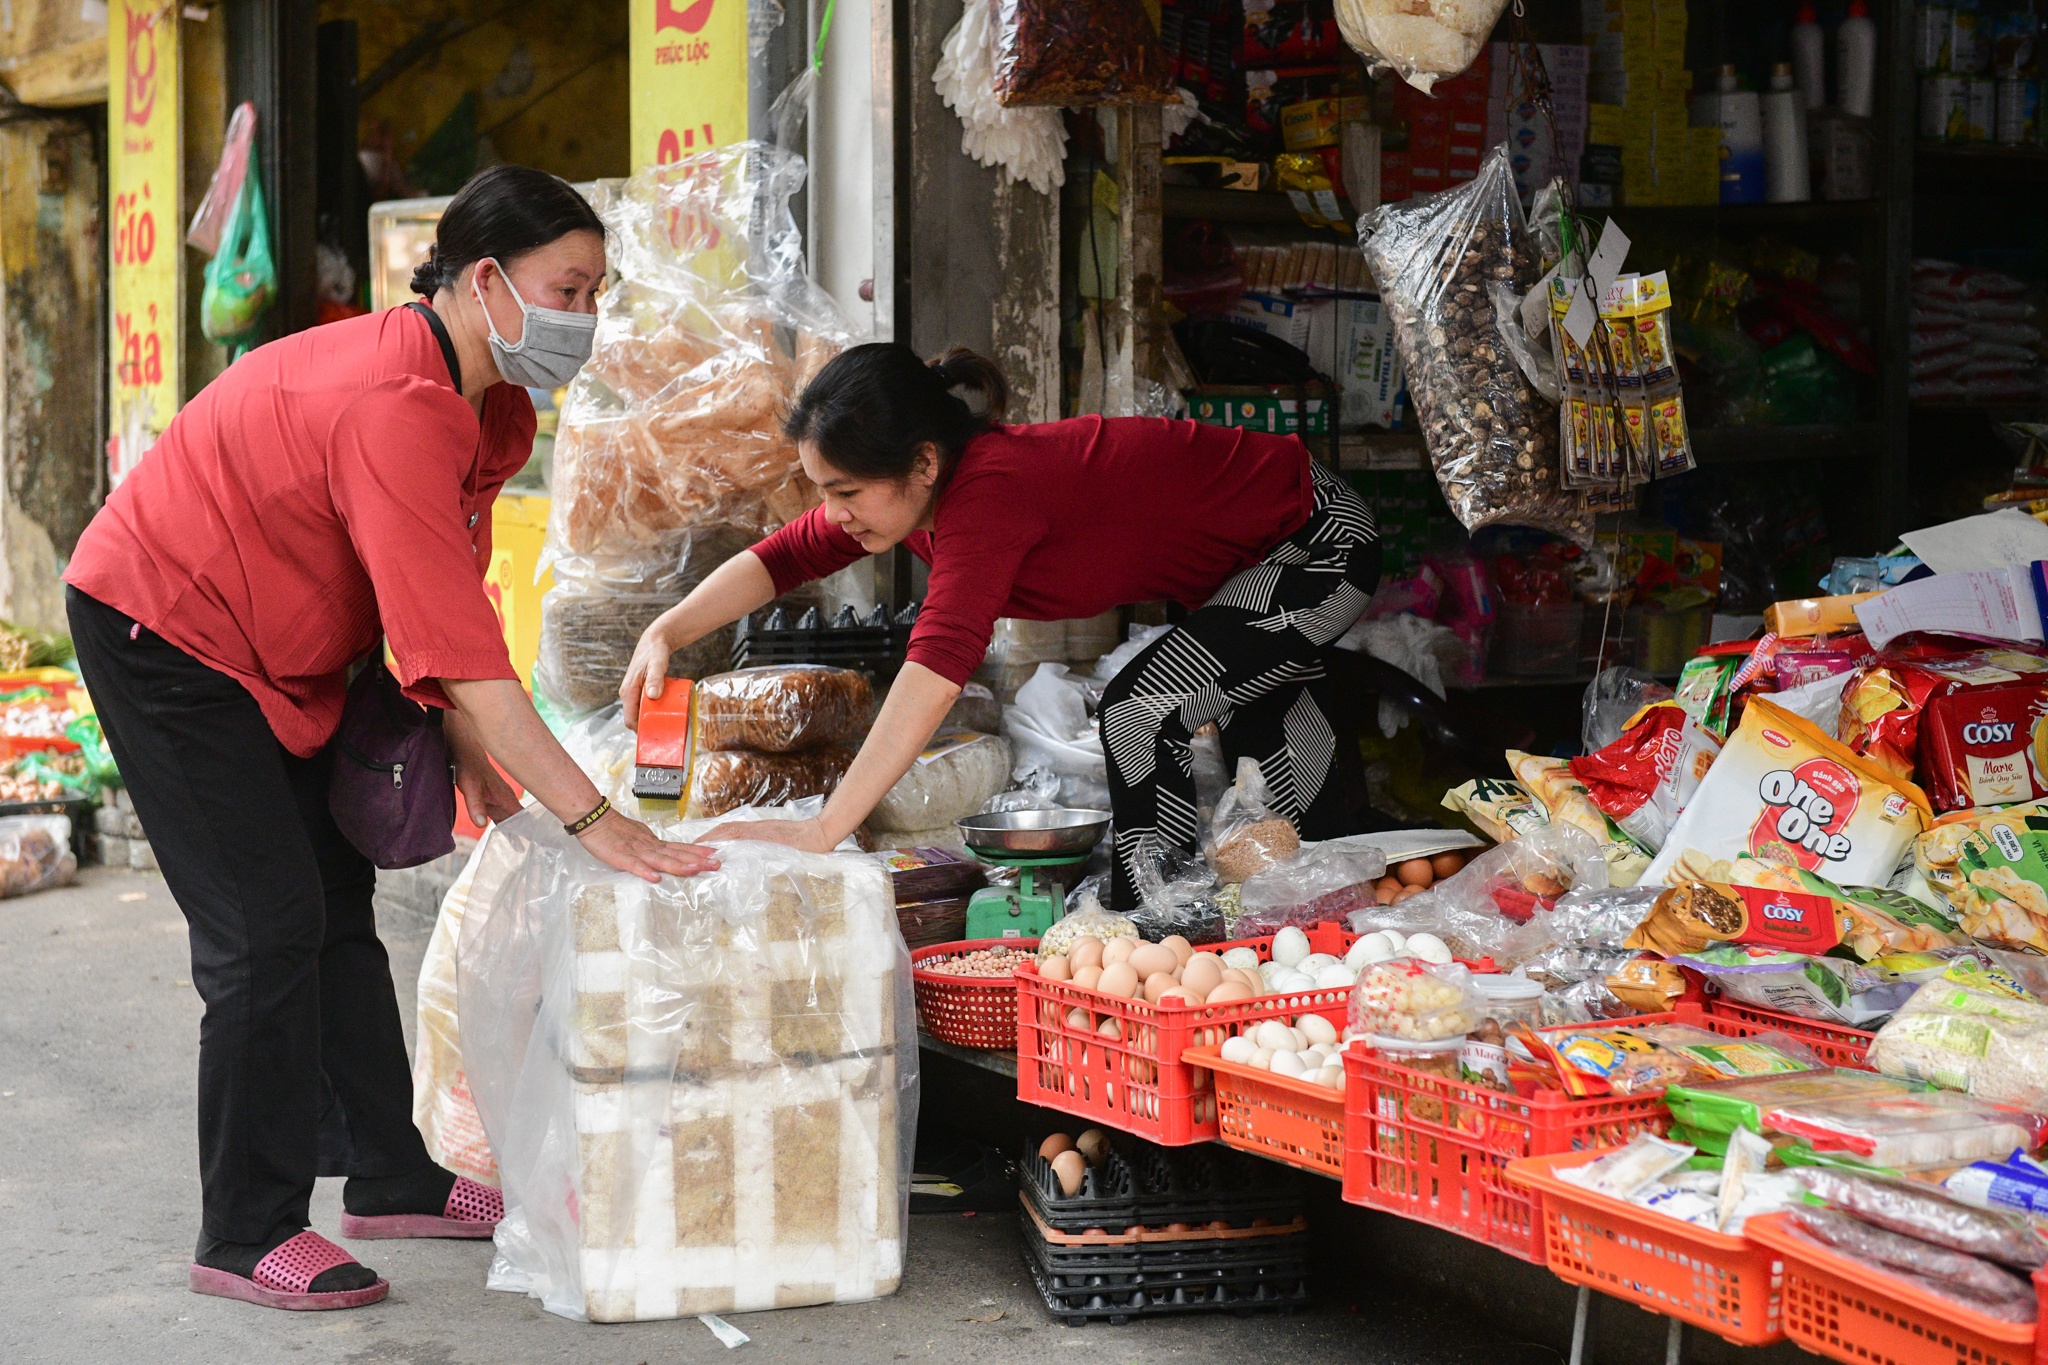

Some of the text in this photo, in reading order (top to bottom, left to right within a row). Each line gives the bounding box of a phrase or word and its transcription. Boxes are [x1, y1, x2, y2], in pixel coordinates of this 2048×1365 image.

[655, 36, 711, 66] PHÚC LỘC
[113, 181, 156, 266] Giò
[1861, 653, 1877, 667] Pie
[1763, 730, 1790, 746] OneOne
[1962, 722, 2016, 745] COSY
[1654, 727, 1683, 784] Karo
[1983, 760, 2014, 775] Marie
[1812, 770, 1833, 782] Bánh
[1831, 779, 1846, 793] gạo
[1759, 769, 1835, 826] One
[1776, 806, 1852, 862] One
[1763, 903, 1805, 922] COSY
[1475, 1047, 1509, 1065] Macca
